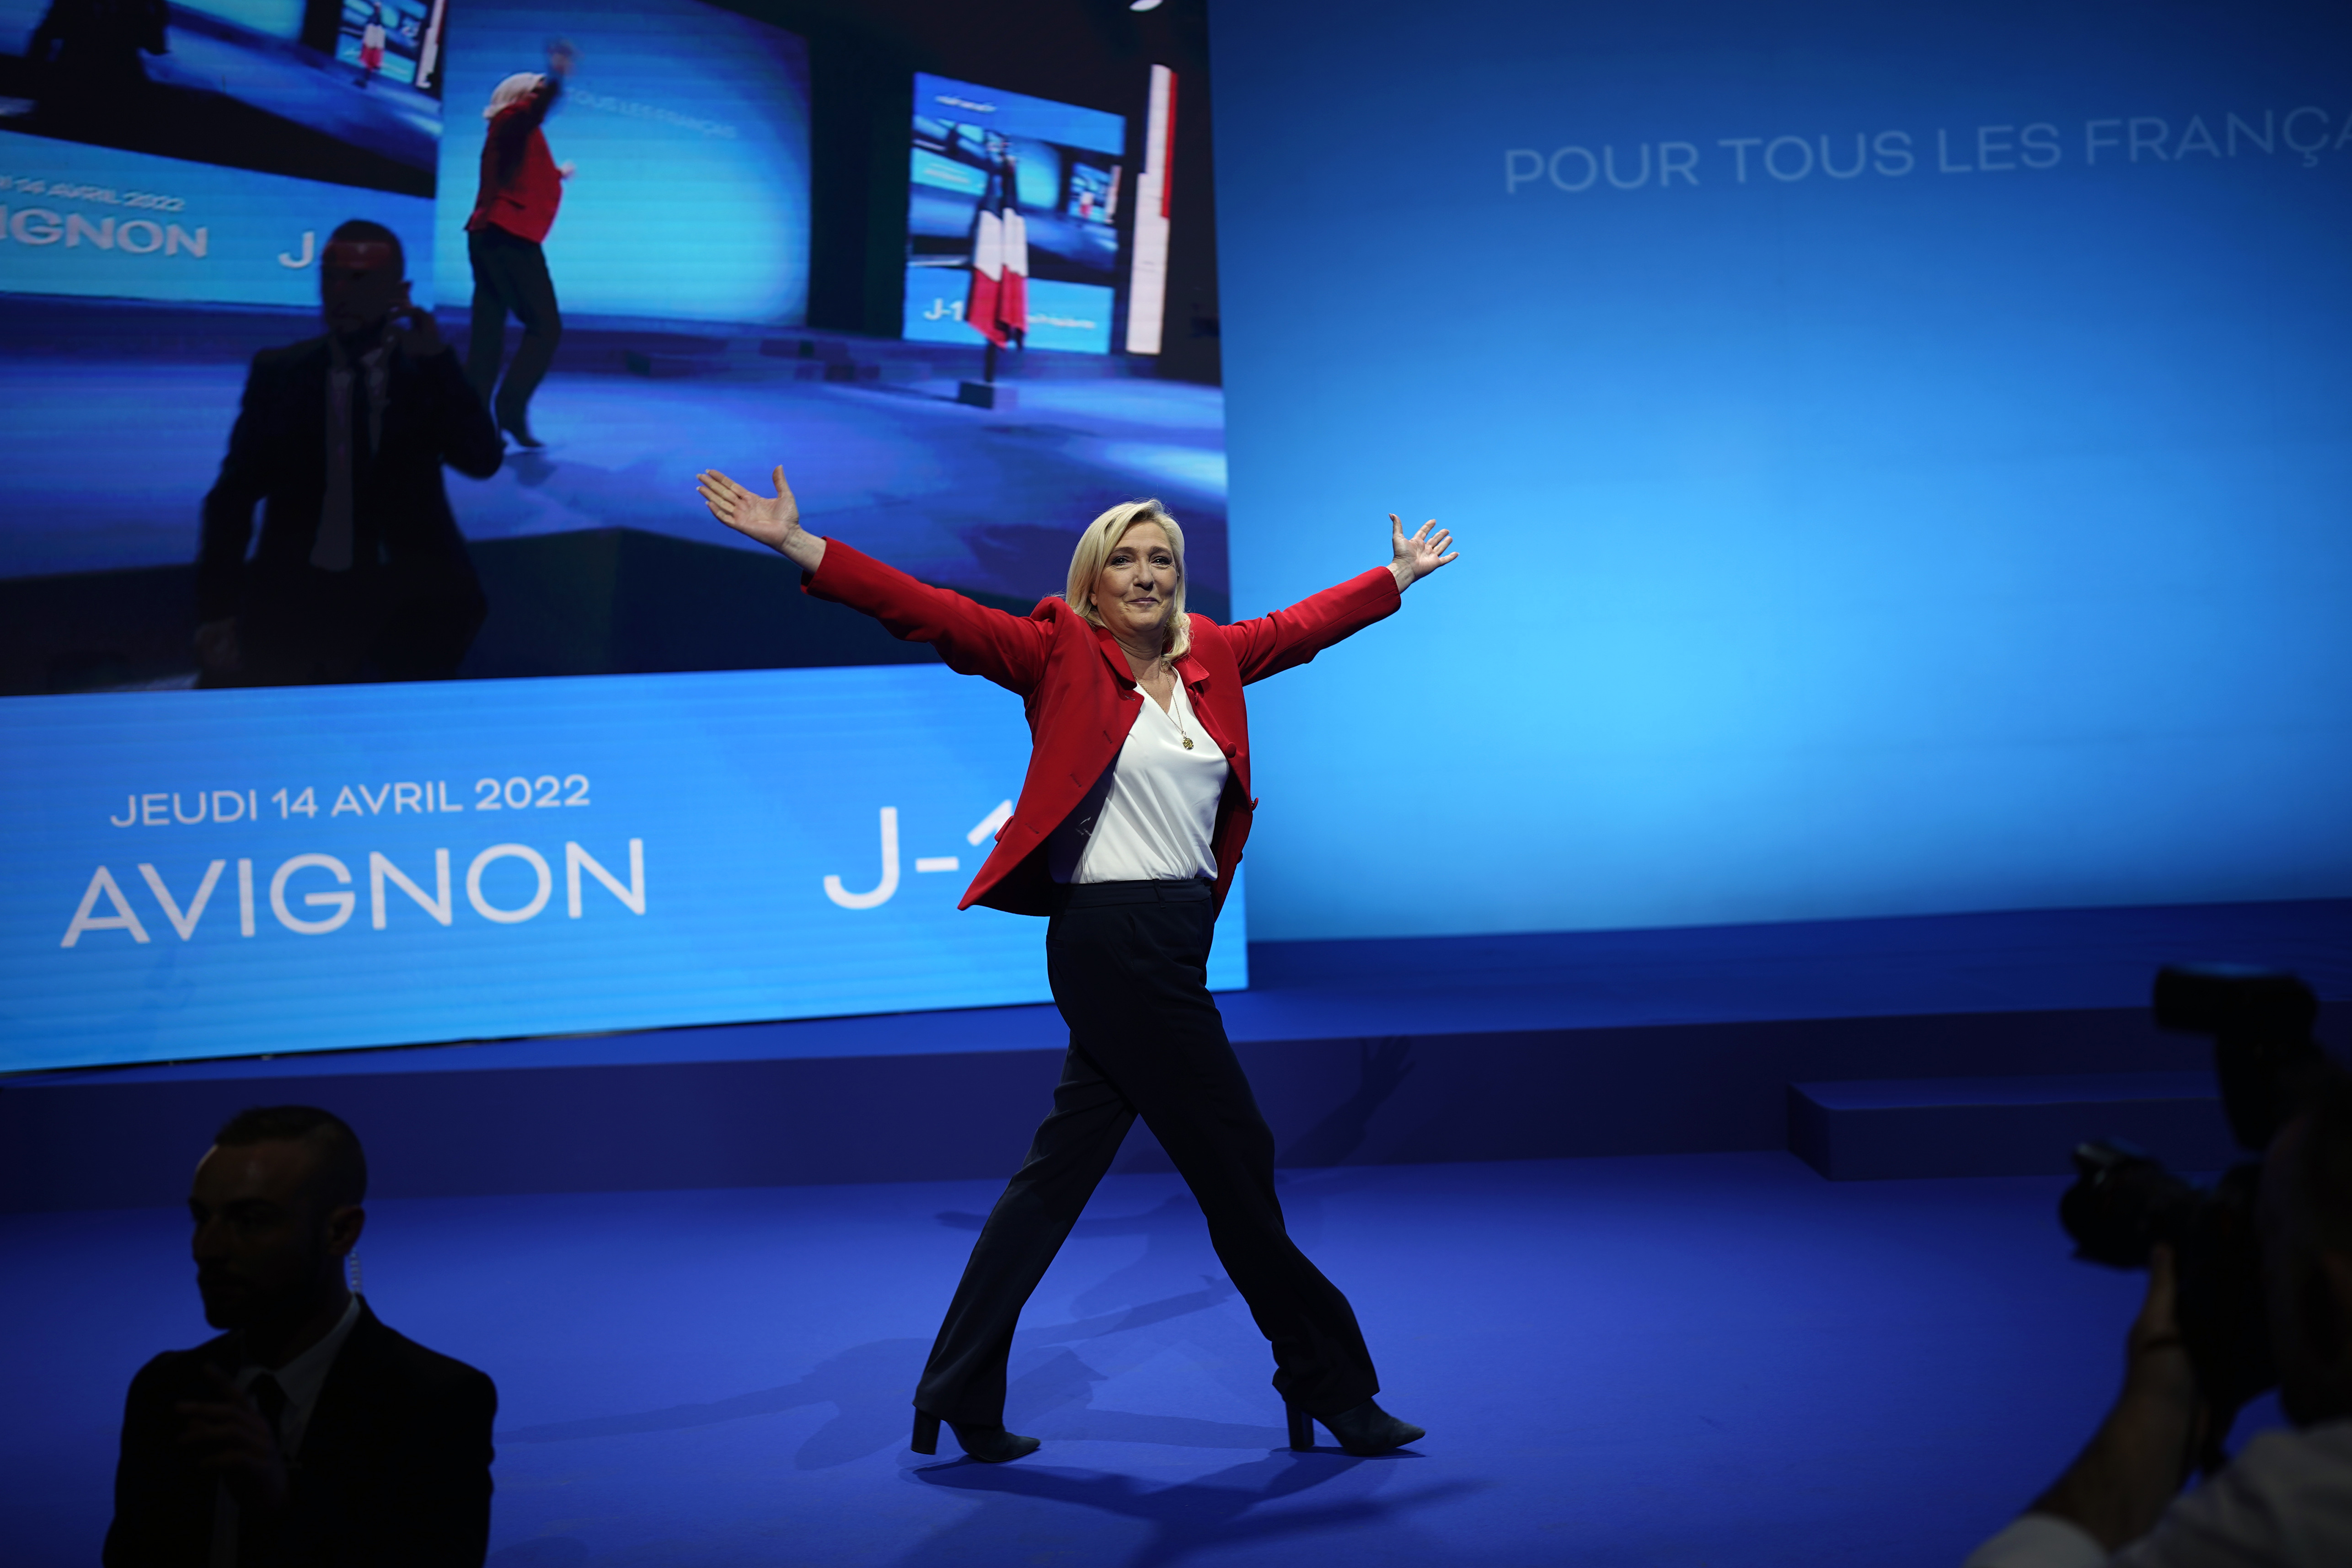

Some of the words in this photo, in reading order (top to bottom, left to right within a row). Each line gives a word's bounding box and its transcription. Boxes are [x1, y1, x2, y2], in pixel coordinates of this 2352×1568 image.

[1505, 141, 1700, 194] POUR
[1717, 129, 1915, 184] TOUS
[1937, 122, 2063, 174] LES
[278, 231, 315, 268] J
[110, 789, 257, 828] JEUDI
[271, 786, 319, 820] 14
[330, 780, 464, 817] AVRIL
[475, 774, 590, 811] 2022
[60, 838, 646, 948] AVIGNON
